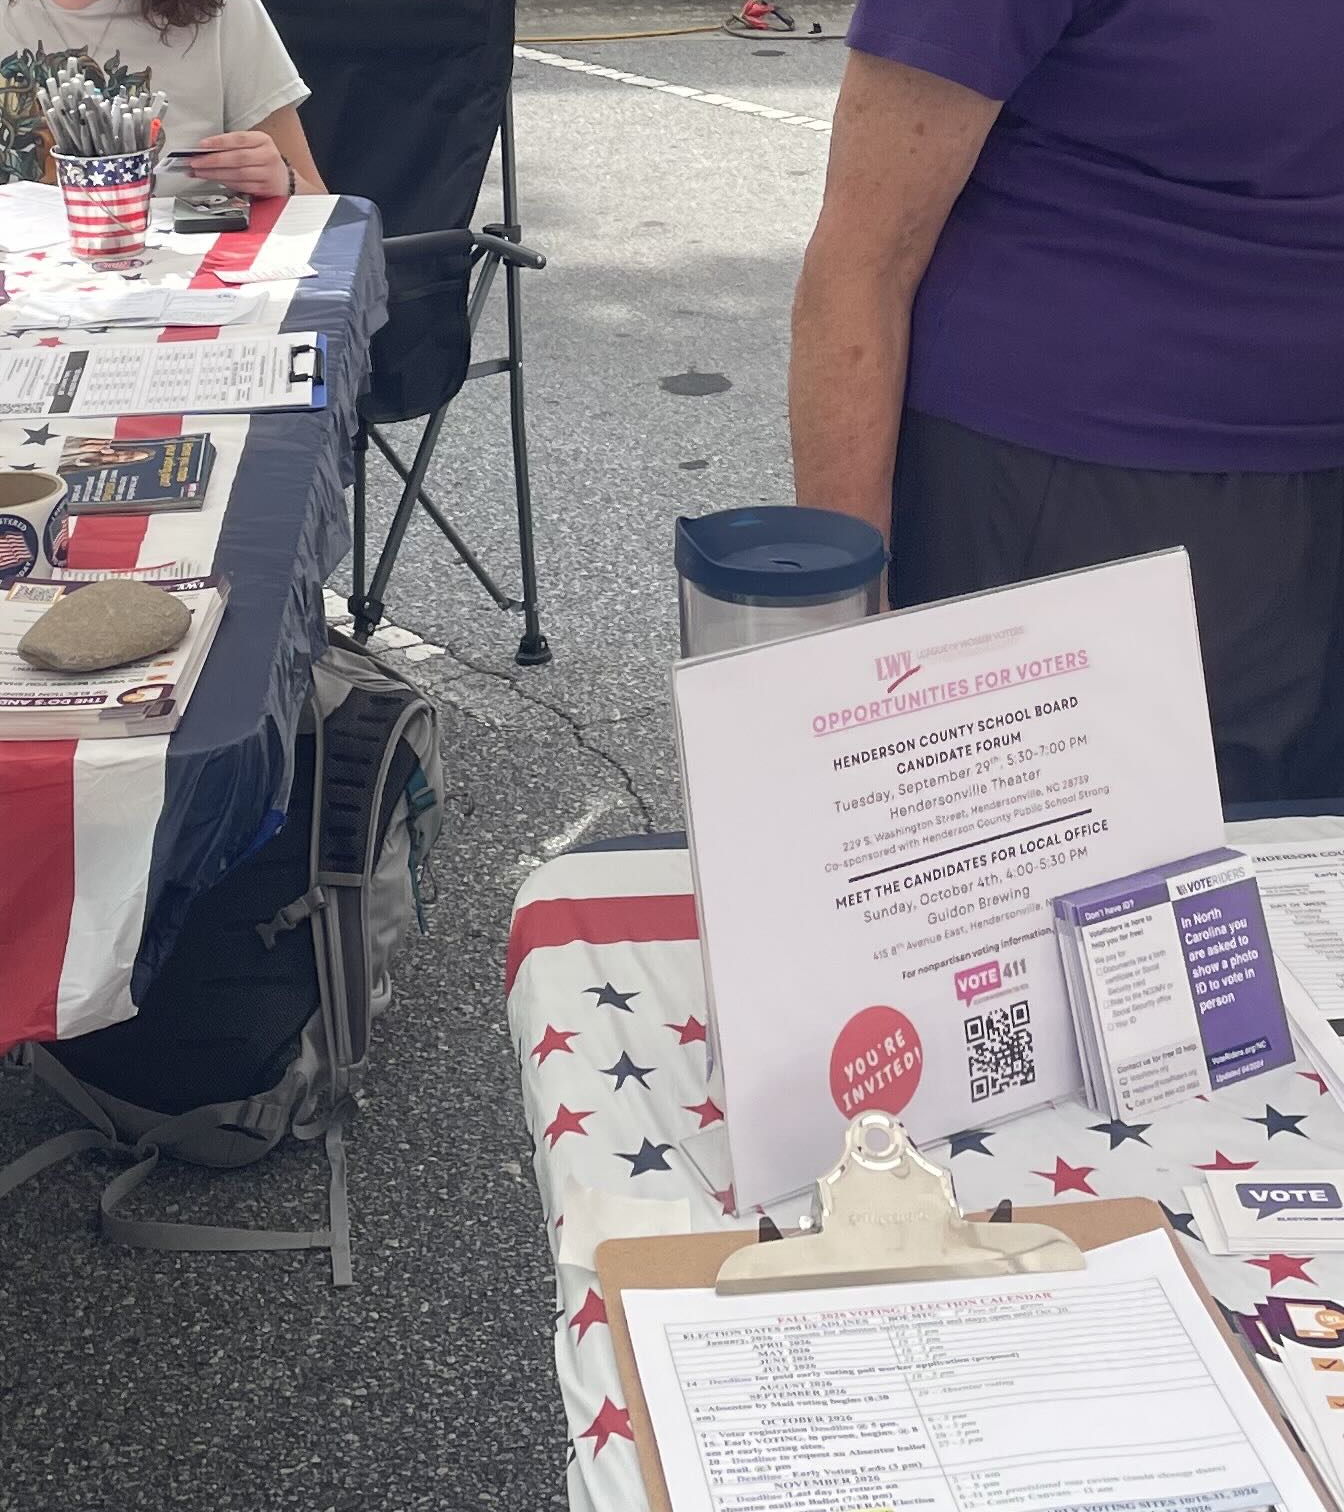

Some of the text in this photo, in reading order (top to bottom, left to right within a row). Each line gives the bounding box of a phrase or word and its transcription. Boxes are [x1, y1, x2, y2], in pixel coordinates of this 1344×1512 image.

[811, 648, 1090, 735] OPPORTUNITIES FOR VOTERS
[874, 650, 913, 682] LWV
[832, 695, 1080, 772] HENDERSON COUNTY SCHOOL BOARD
[896, 731, 1023, 775] CANDIDATE FORUM
[834, 790, 895, 813] Tuesday,
[897, 766, 972, 797] September
[1069, 734, 1088, 748] PM
[889, 768, 1041, 820] Hendersonville Theater
[835, 819, 1110, 910] MEET THE CANDIDATES FOR LOCAL OFFICE
[956, 958, 1028, 993] VOTE 411
[841, 1045, 922, 1112] INVITED!
[1248, 1188, 1329, 1203] VOTE
